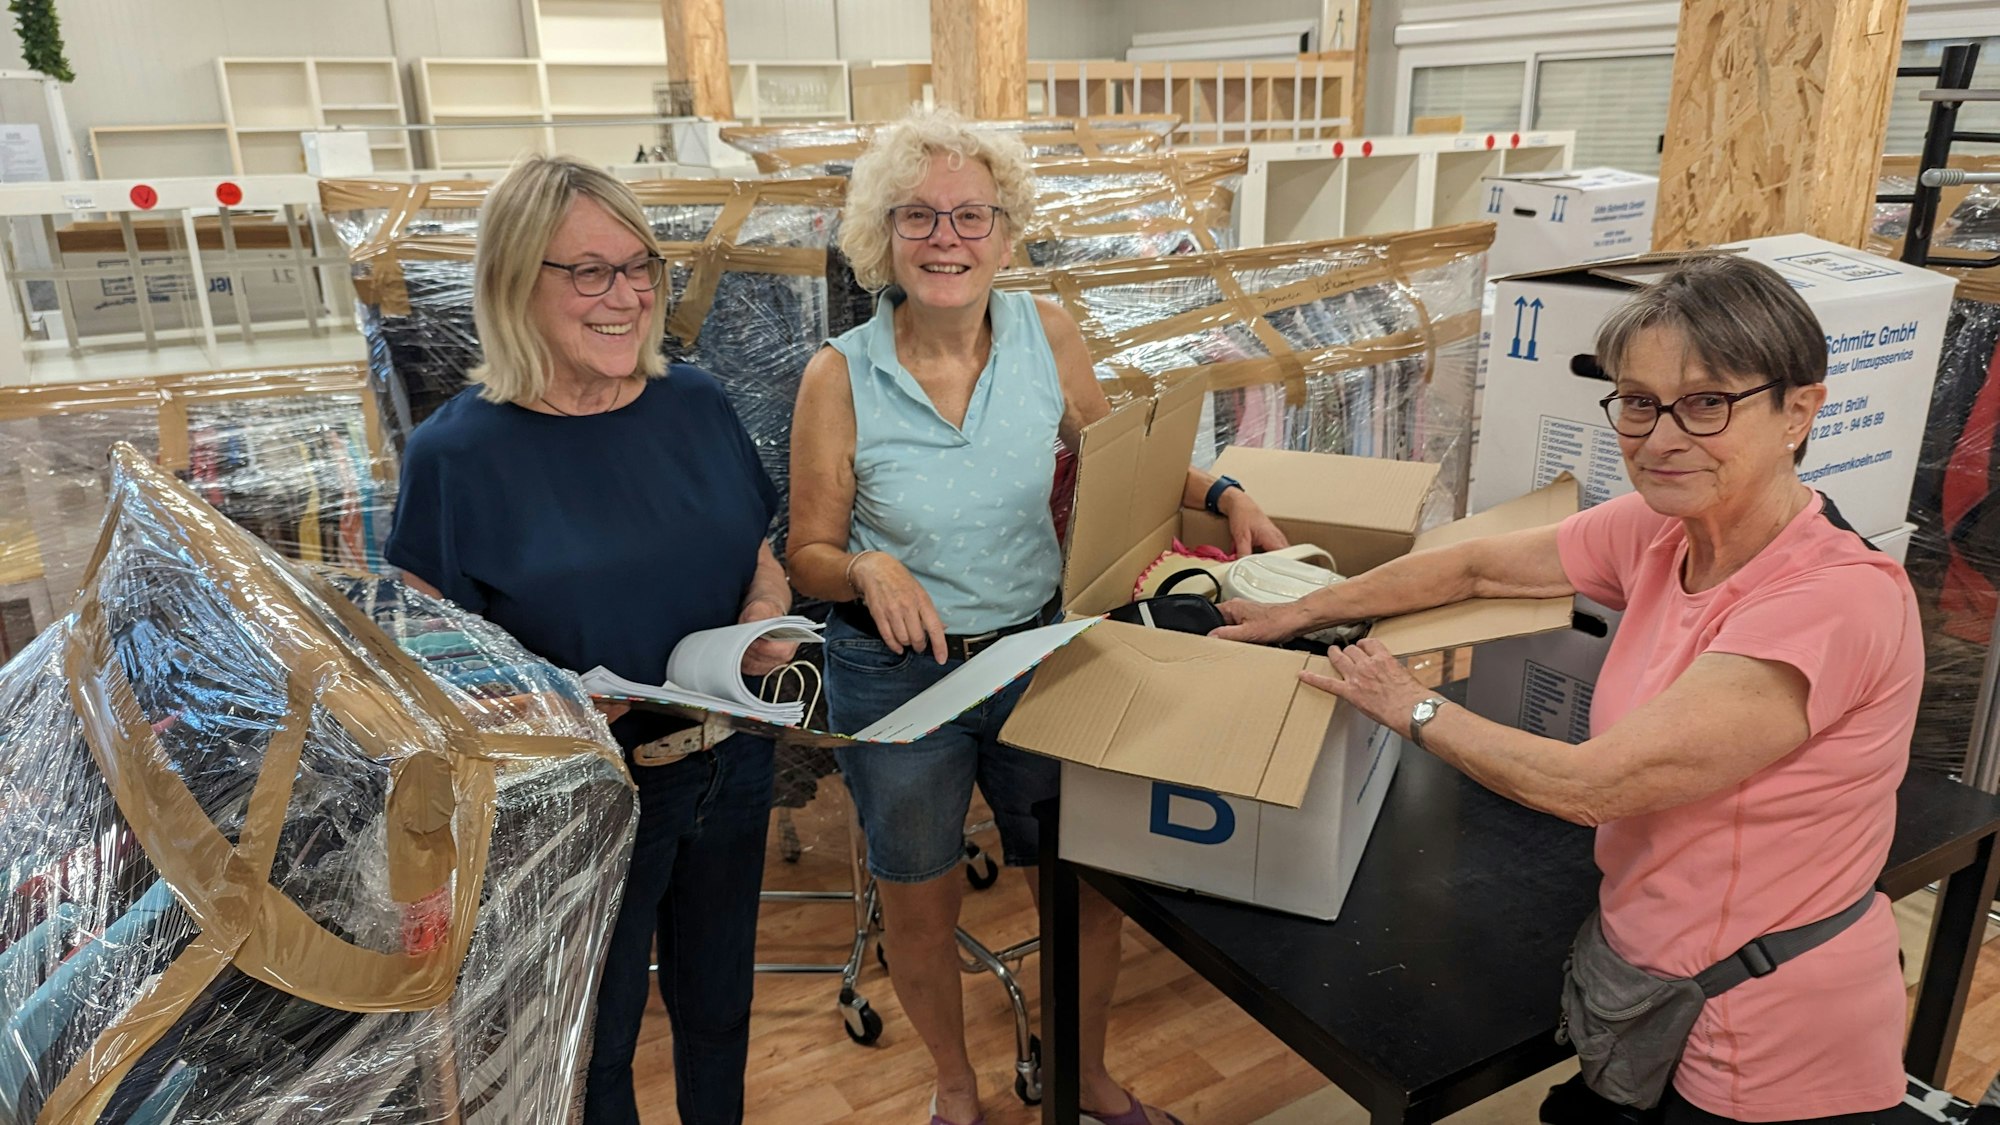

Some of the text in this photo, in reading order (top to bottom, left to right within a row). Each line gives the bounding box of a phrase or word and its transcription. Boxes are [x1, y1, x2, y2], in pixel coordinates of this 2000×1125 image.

[209, 276, 233, 296] ier
[1824, 320, 1918, 355] Schmitz GmbH
[1825, 349, 1914, 377] naler Umzugsservice
[1845, 395, 1869, 413] Brühl
[1819, 424, 1831, 439] 22
[1832, 421, 1844, 435] 32
[1850, 416, 1861, 432] 94
